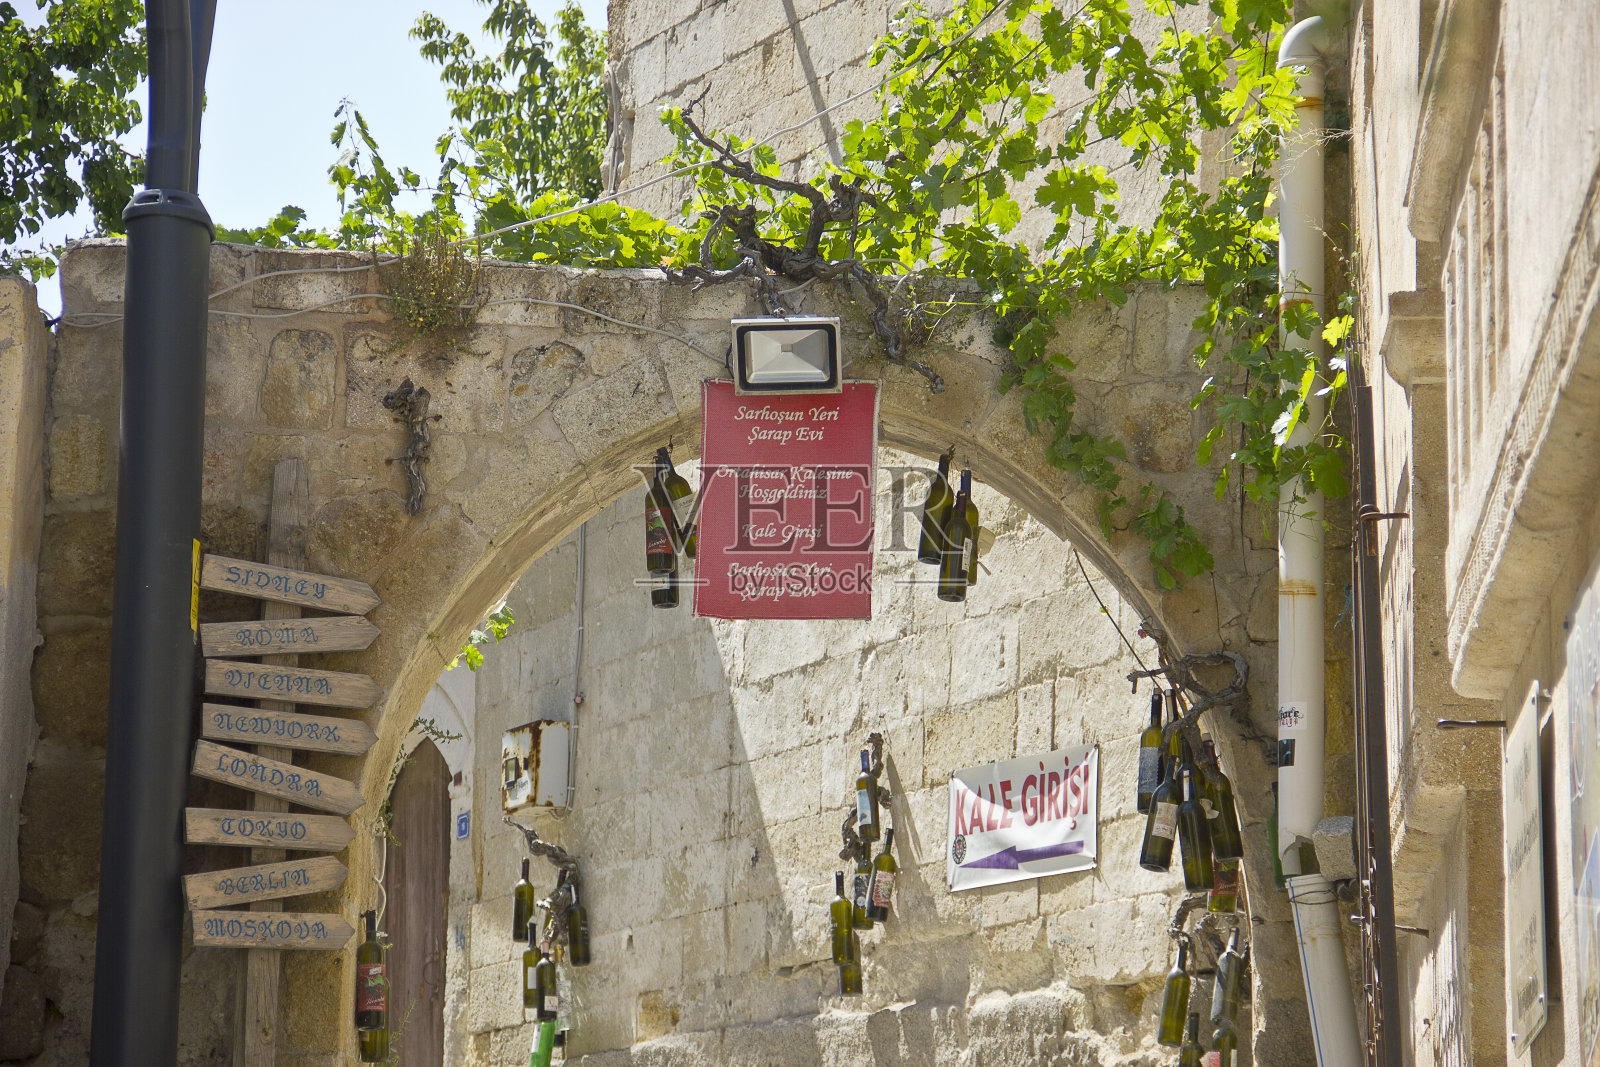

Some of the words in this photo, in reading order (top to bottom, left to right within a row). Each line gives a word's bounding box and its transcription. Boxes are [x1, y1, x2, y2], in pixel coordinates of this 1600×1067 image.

[734, 405, 804, 424] Sarhoşun
[808, 407, 840, 421] Yeri
[747, 426, 792, 445] Şarap
[795, 427, 825, 441] Evi
[716, 463, 787, 481] Ortahisar
[790, 465, 854, 482] Kalesine
[738, 484, 828, 503] Hoşgeldiniz
[741, 523, 776, 540] Kale
[781, 524, 823, 543] Girişi
[727, 561, 798, 581] Sarhoşun
[801, 562, 833, 577] Yeri
[225, 566, 326, 600] SIDNEY
[235, 627, 319, 646] ROMA
[224, 669, 332, 695] VIENNA
[213, 712, 341, 743] NEWYORK
[216, 753, 322, 797] LONDRA
[954, 779, 1014, 837] KALE
[1020, 752, 1090, 830] GİRİŞİ
[221, 817, 307, 840] TOKYO
[219, 868, 310, 895] BERLIN
[204, 918, 329, 941] MOSKOVA
